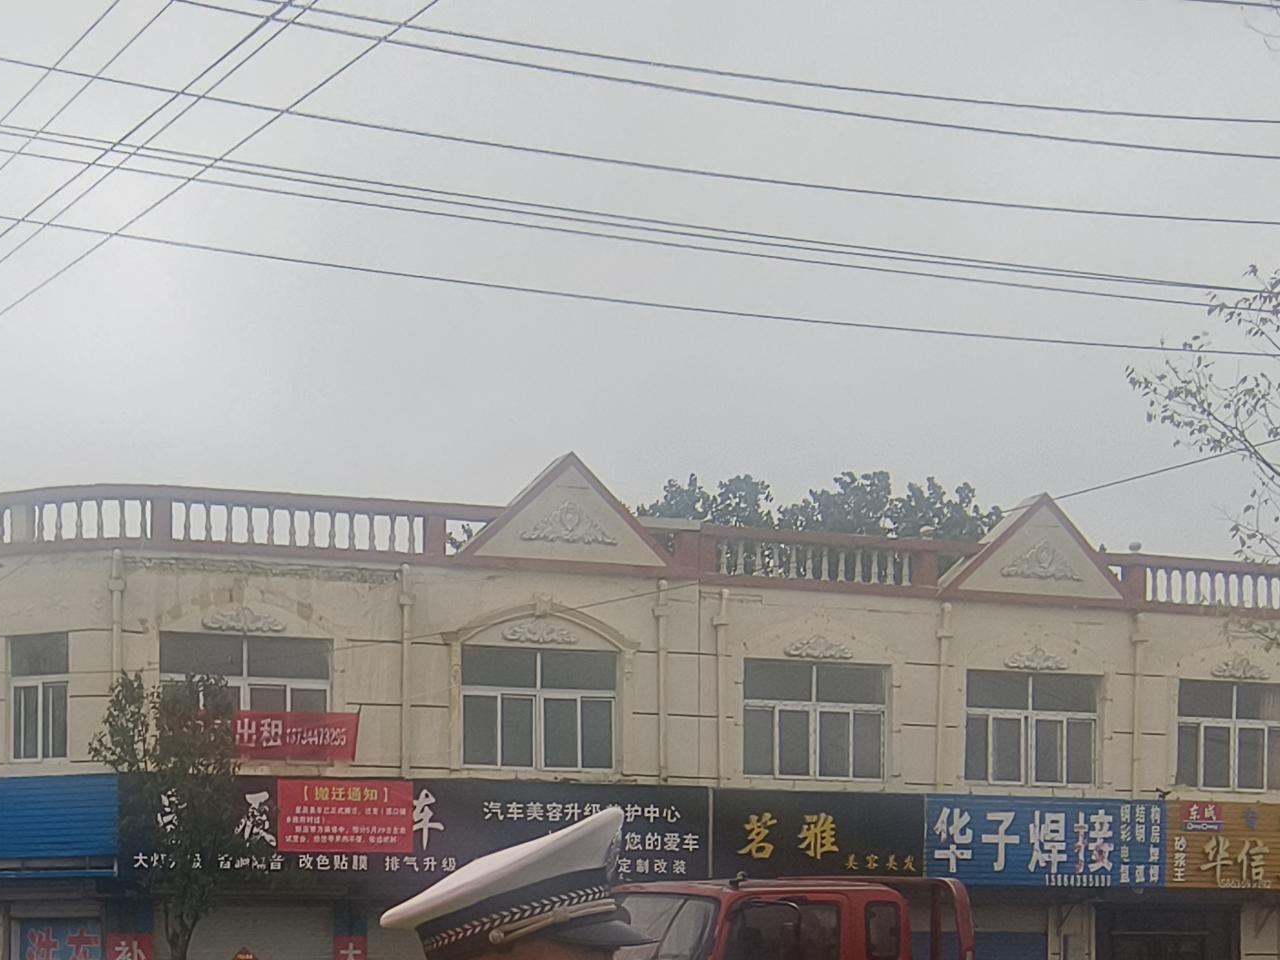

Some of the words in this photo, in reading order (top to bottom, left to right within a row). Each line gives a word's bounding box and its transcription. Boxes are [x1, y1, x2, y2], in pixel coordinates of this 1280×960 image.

[235, 718, 283, 747] 出租
[738, 812, 840, 860] 茗雅
[934, 806, 1114, 873] 华子焊接
[133, 853, 202, 869] 大灯级
[299, 854, 369, 871] 改色贴膜
[385, 855, 457, 873] 排气升级
[845, 854, 916, 872] 美容美发
[1200, 836, 1270, 885] 华信
